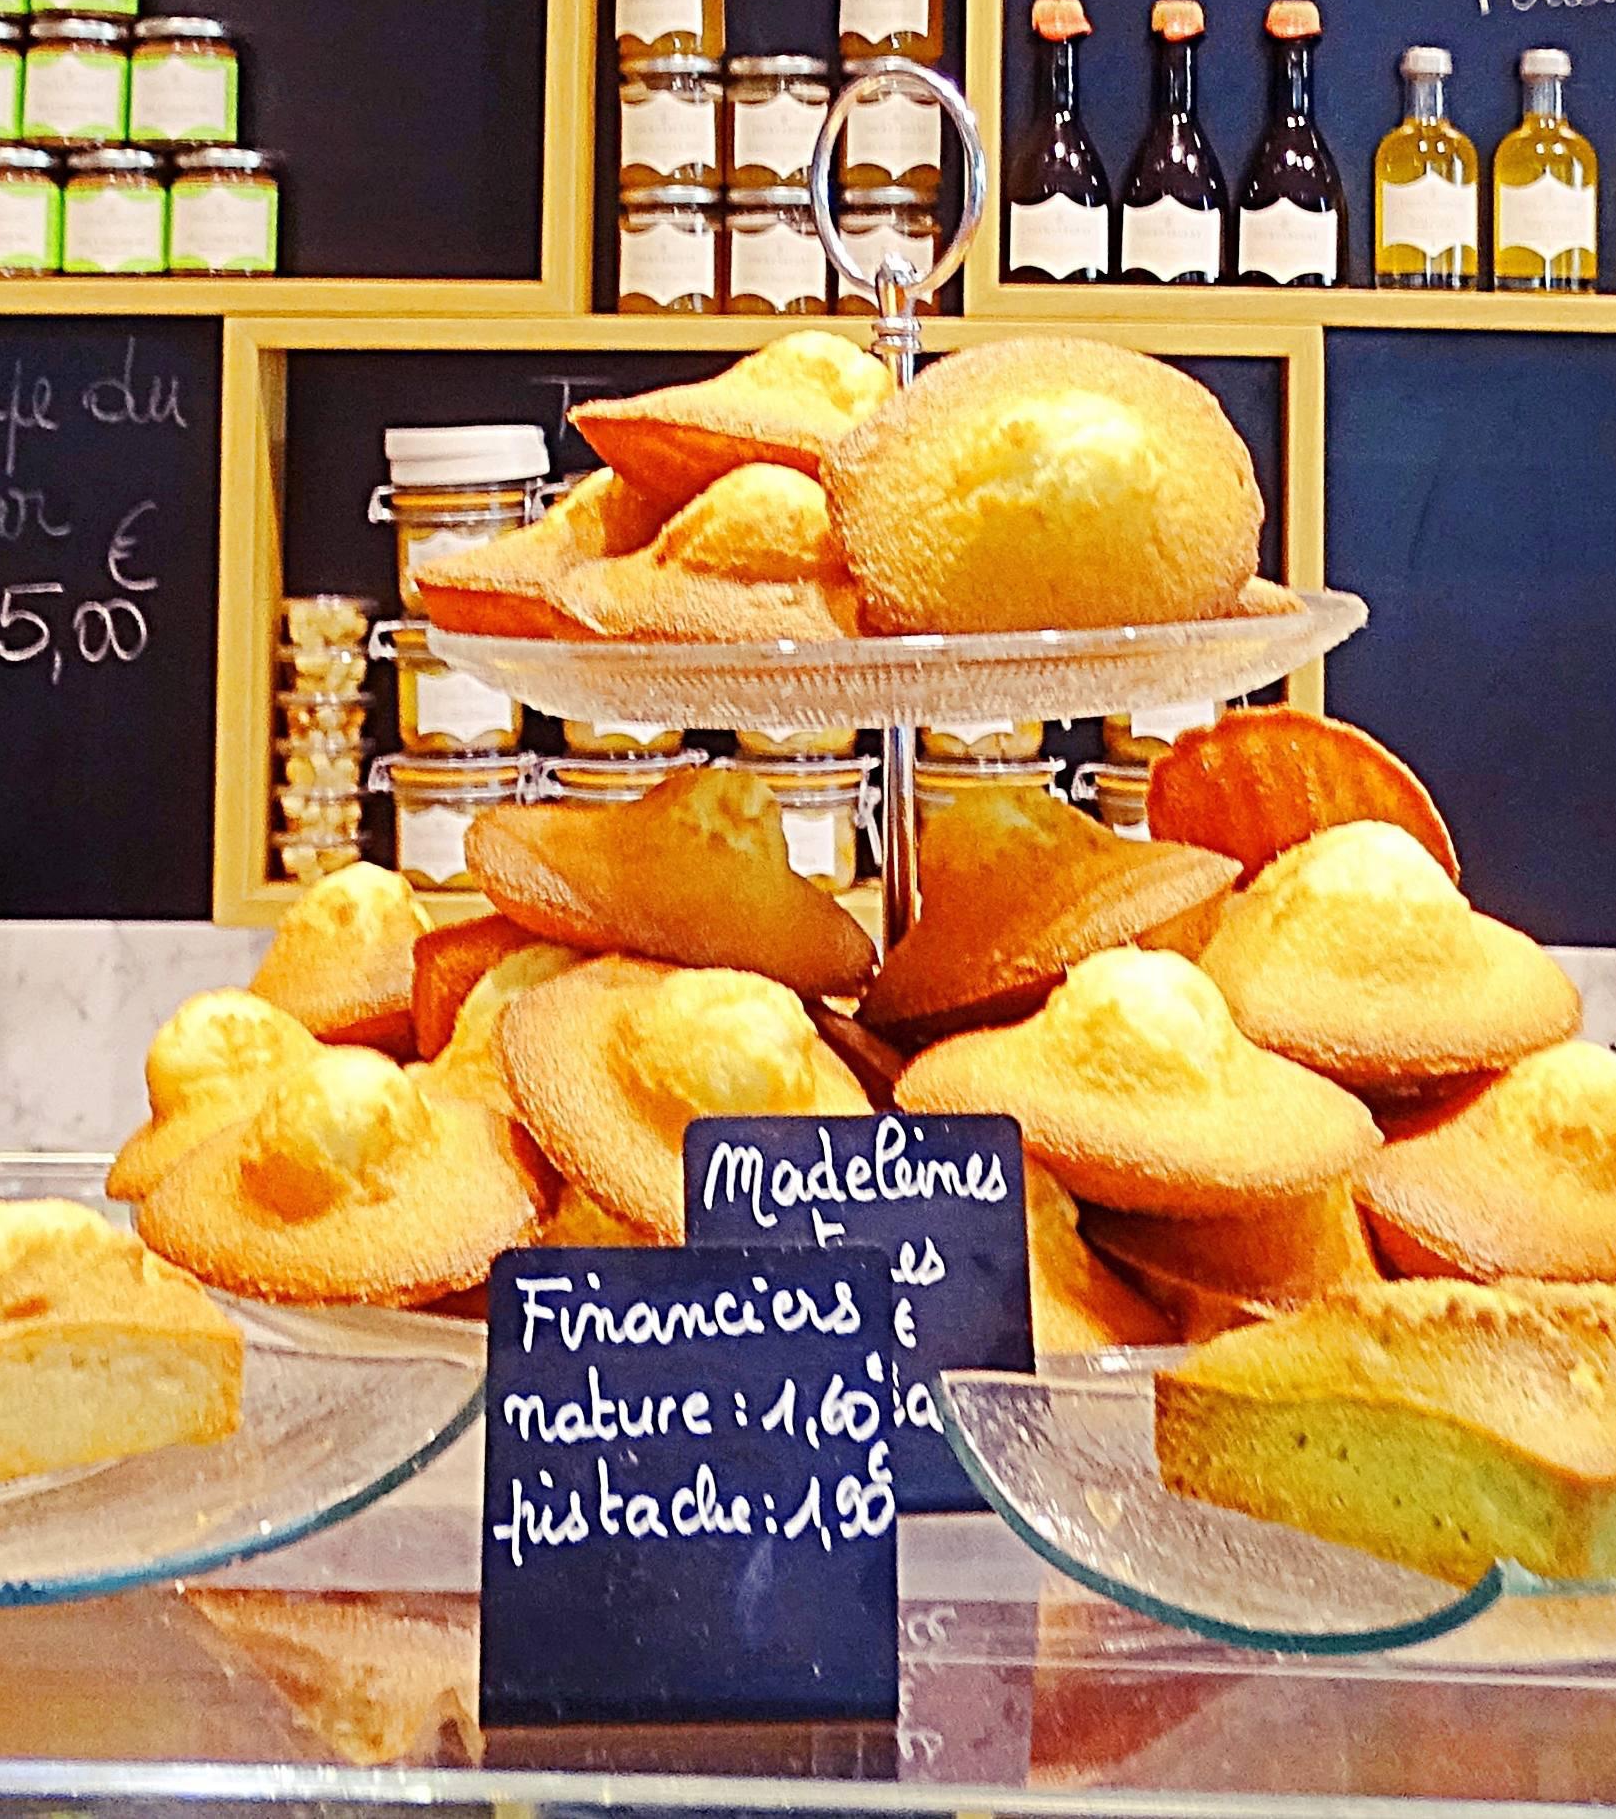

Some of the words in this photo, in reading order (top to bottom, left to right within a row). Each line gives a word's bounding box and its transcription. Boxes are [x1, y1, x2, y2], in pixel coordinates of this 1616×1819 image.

[83, 335, 188, 429] du
[702, 1115, 1009, 1229] Madeleines
[515, 1273, 861, 1353] Financiers
